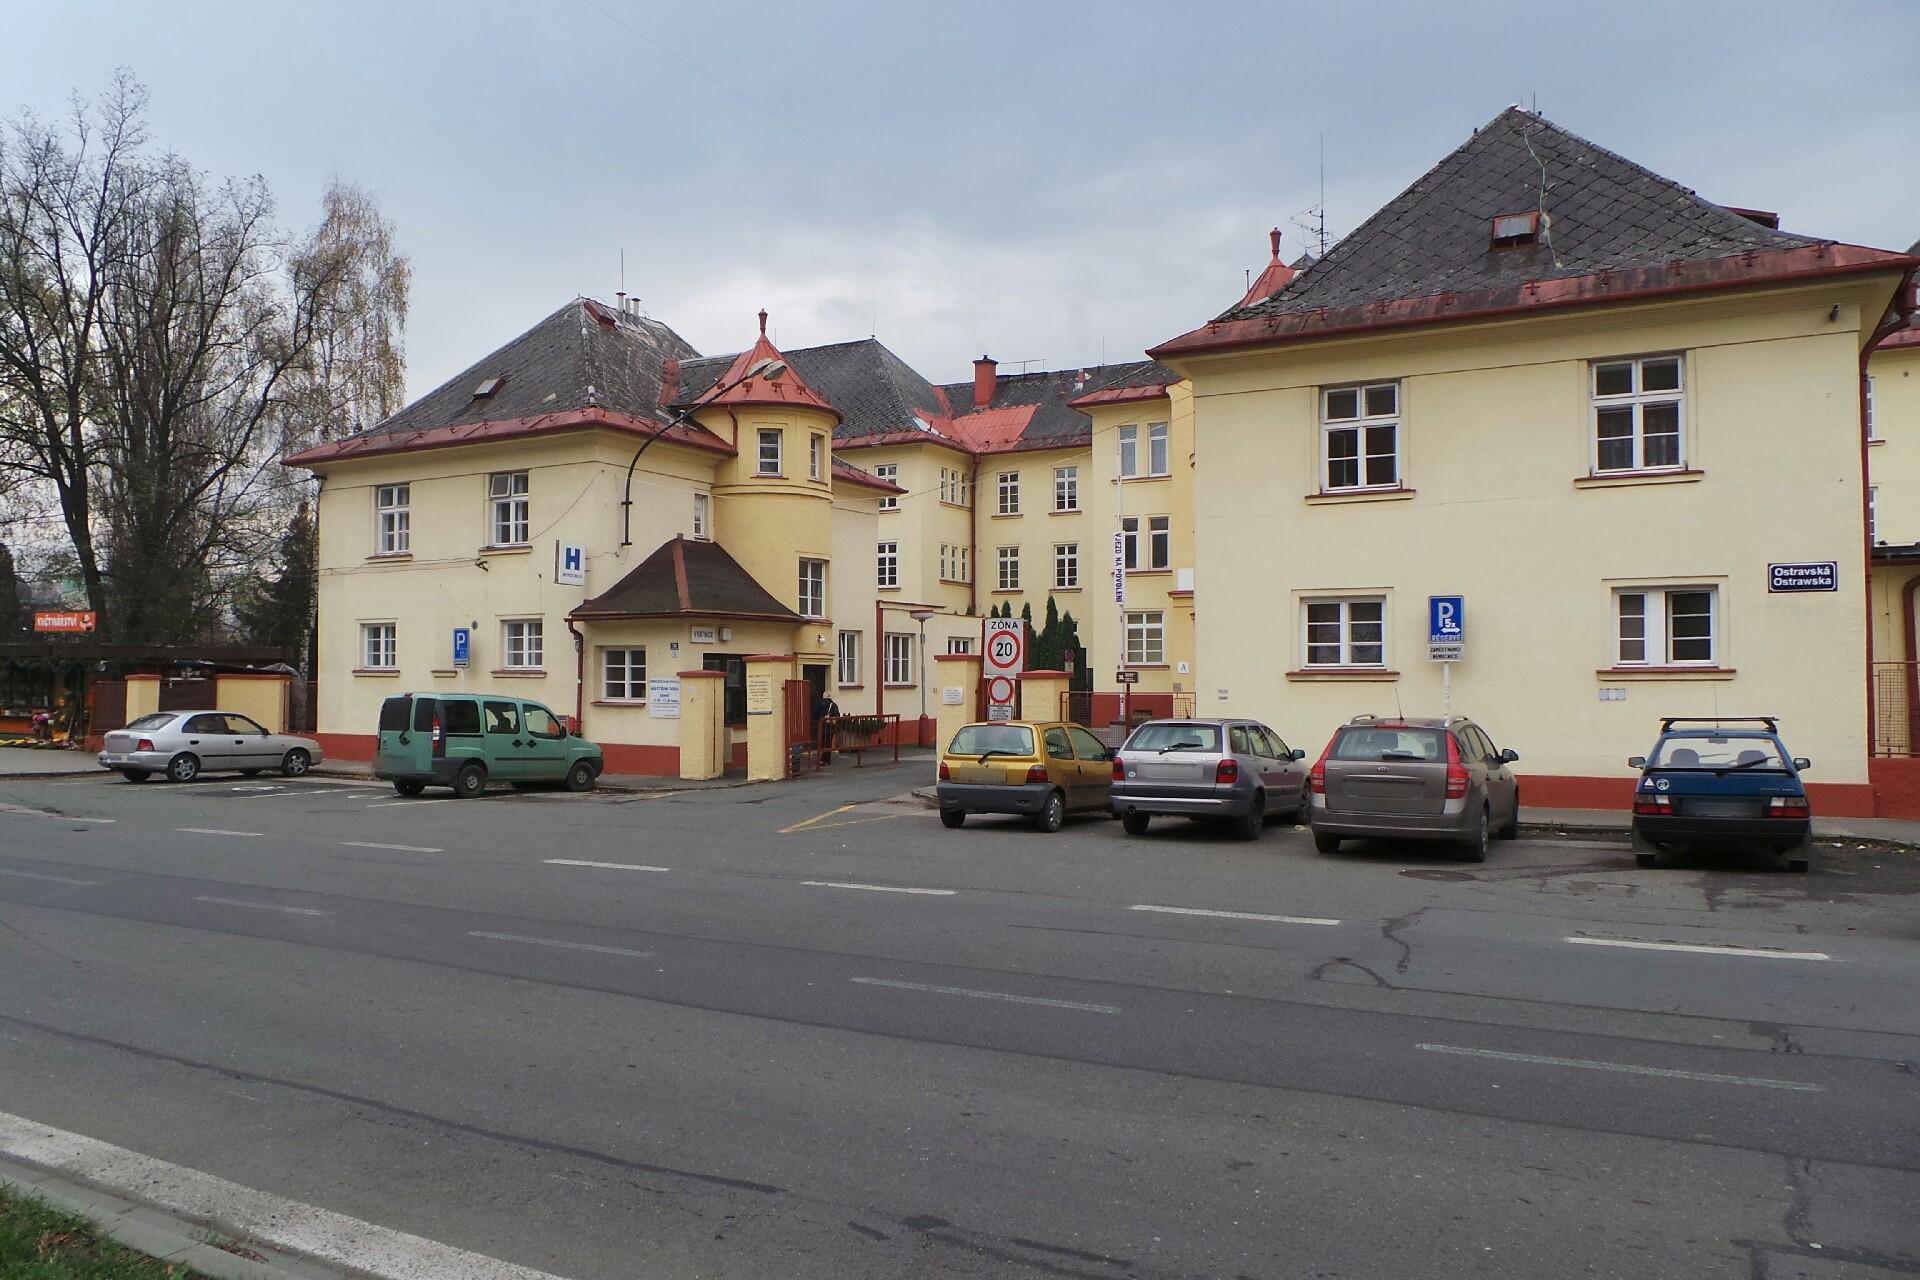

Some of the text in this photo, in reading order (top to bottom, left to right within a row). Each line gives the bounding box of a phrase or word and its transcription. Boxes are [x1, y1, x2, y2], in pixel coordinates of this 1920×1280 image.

[565, 547, 581, 571] H
[1115, 557, 1122, 567] NA
[1774, 566, 1831, 577] Ostravská
[1773, 576, 1832, 587] Ostrawska
[1438, 602, 1454, 628] P
[991, 620, 1019, 630] ZÓNA
[456, 632, 466, 651] P
[995, 642, 1013, 657] 20
